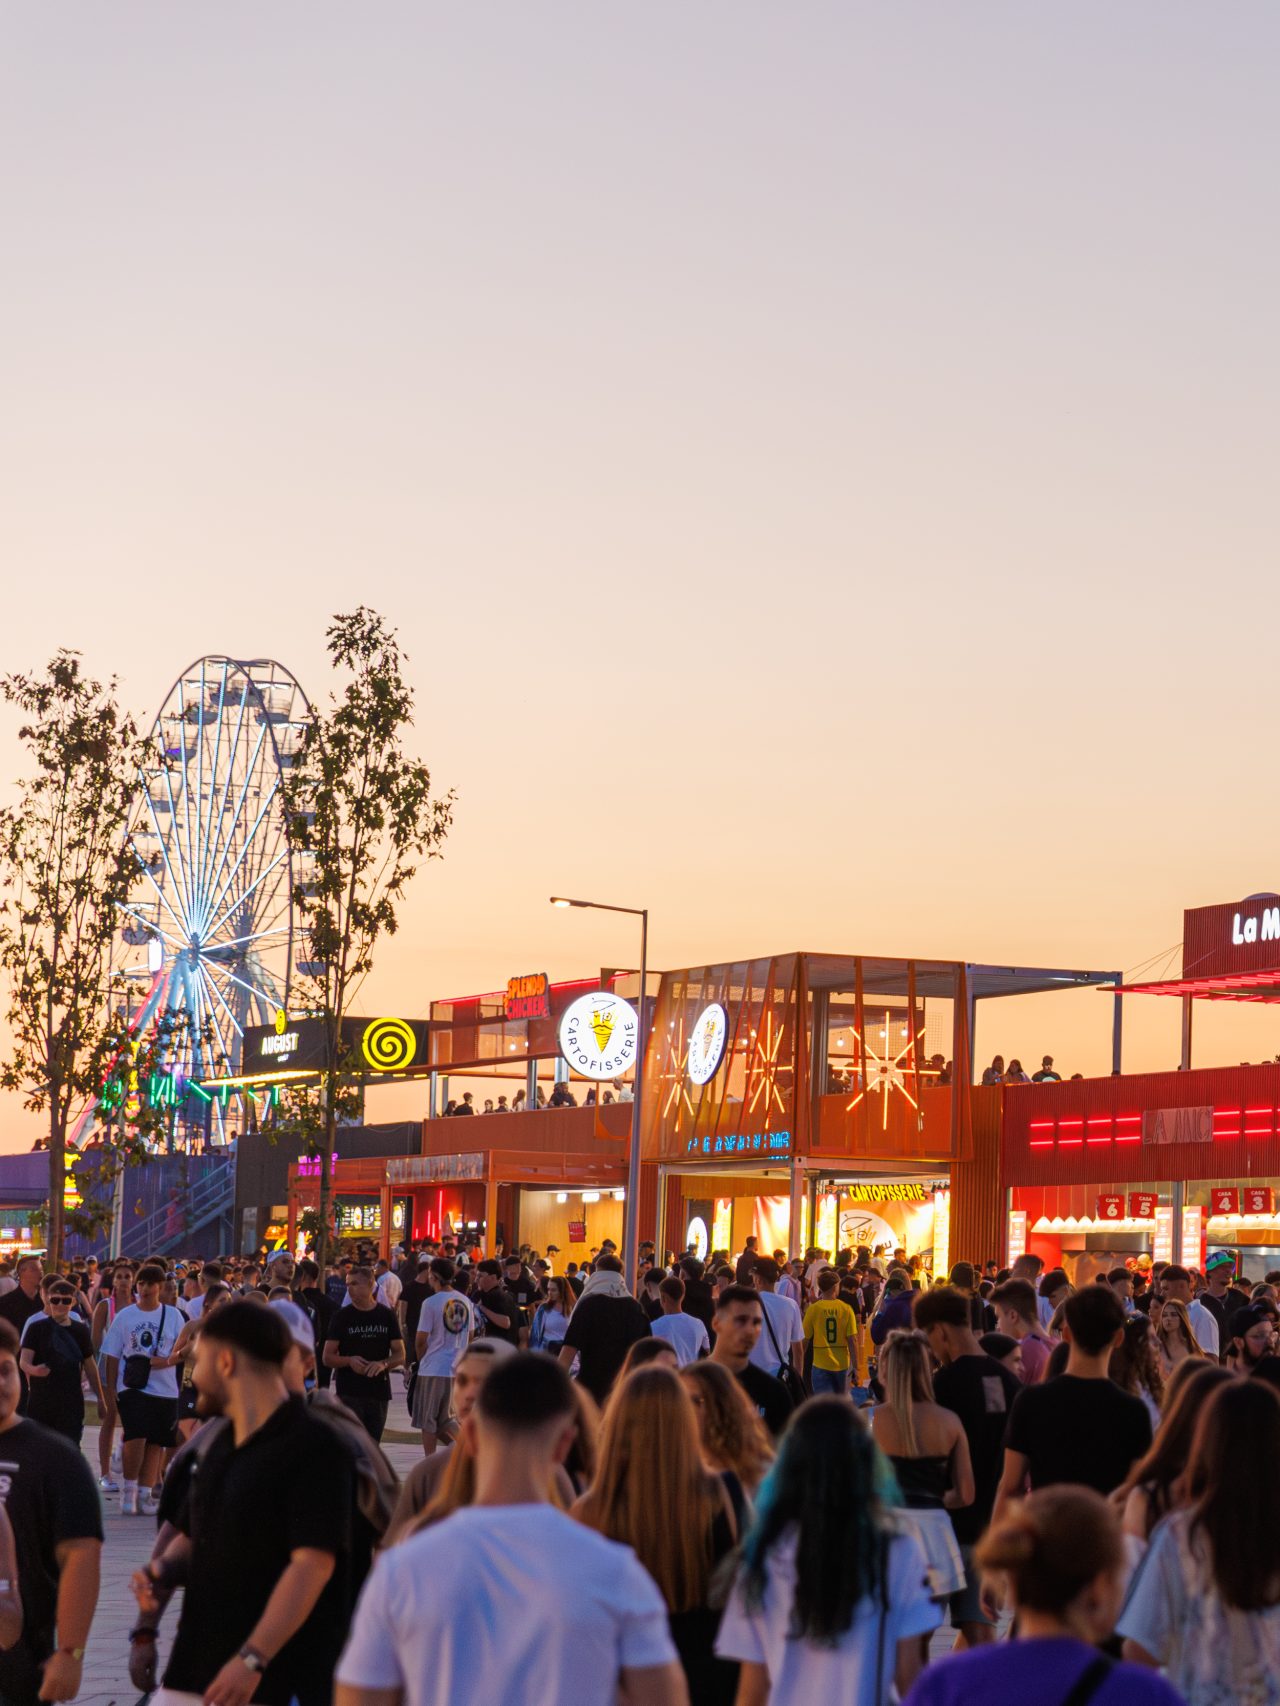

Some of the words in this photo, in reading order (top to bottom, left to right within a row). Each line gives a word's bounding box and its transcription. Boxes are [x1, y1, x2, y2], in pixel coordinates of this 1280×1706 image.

[1232, 912, 1257, 945] La
[261, 1032, 299, 1056] AUGUST
[567, 1017, 635, 1071] CARTOFISSERIE
[849, 1184, 926, 1202] CARTOFISSERIE
[1107, 1204, 1118, 1217] 6
[1139, 1202, 1151, 1215] 5
[1219, 1197, 1231, 1210] 4
[1252, 1197, 1264, 1210] 3
[826, 1317, 838, 1344] 8
